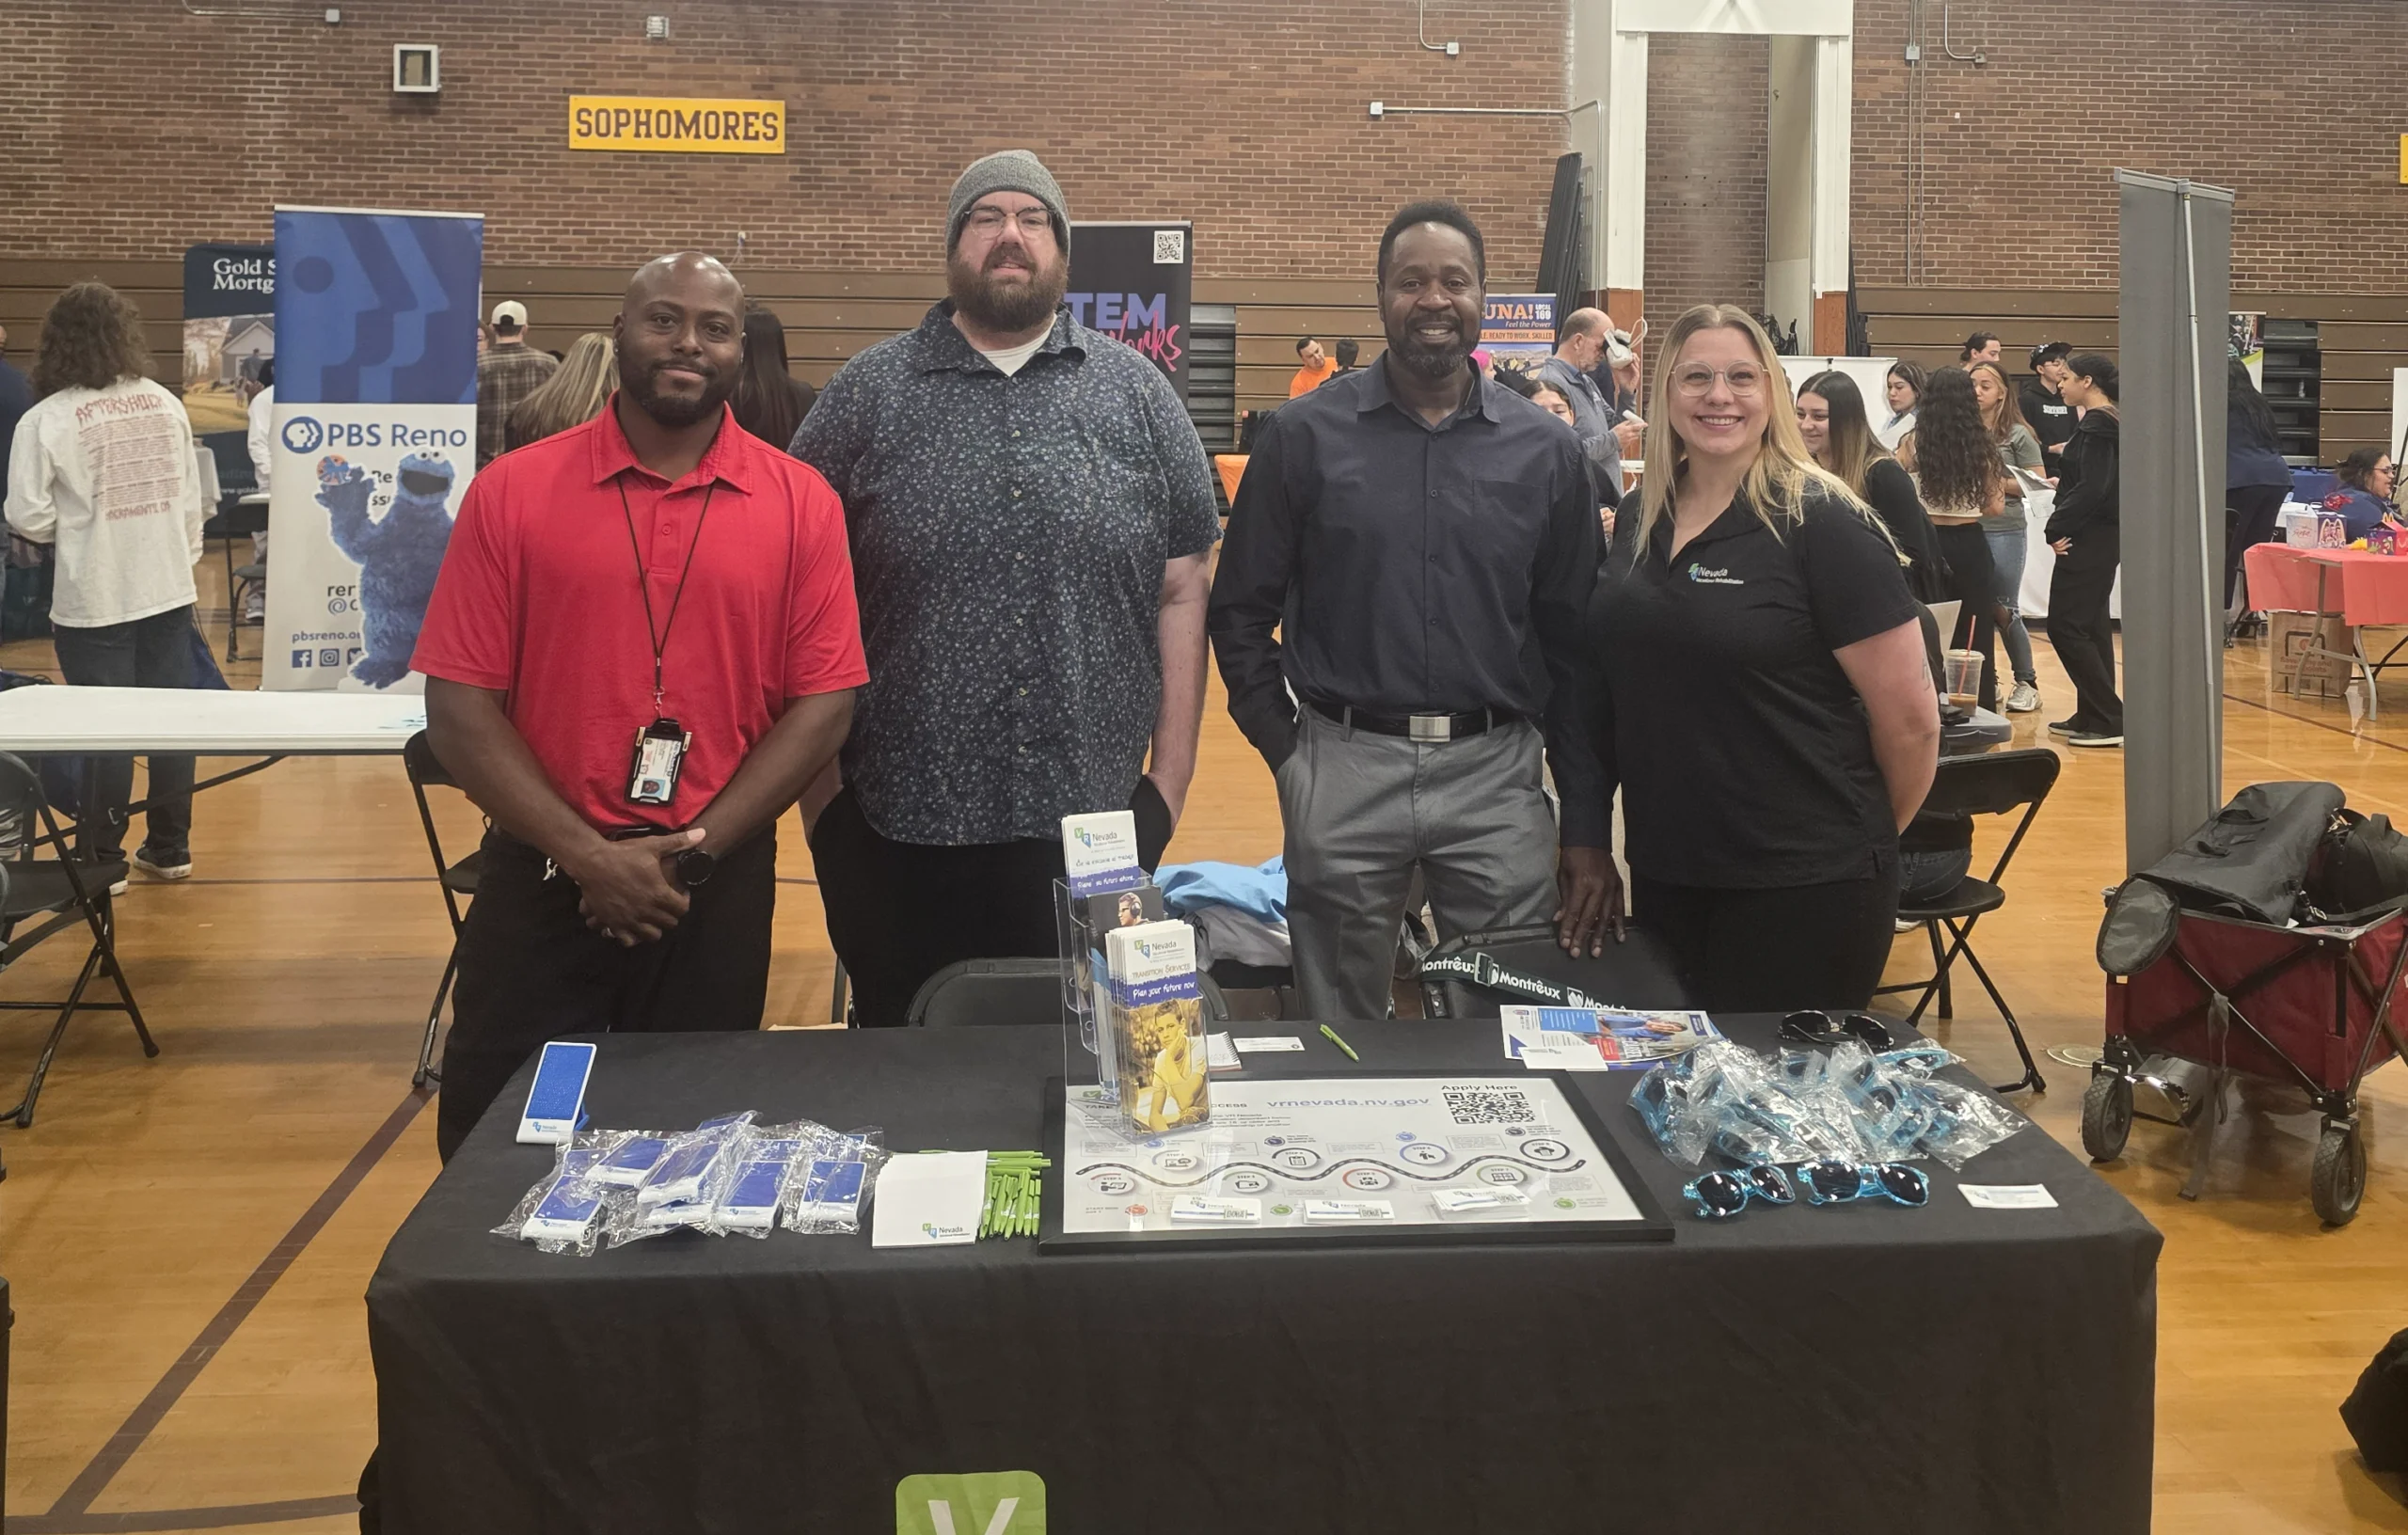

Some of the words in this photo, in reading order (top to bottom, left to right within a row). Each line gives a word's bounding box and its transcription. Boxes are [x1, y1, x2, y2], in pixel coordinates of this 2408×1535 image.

[576, 107, 779, 141] SOPHOMORES
[213, 257, 262, 275] Gold
[267, 259, 277, 275] S
[213, 274, 275, 294] Mortg
[1063, 293, 1166, 330] TEM
[1484, 304, 1533, 320] UNA!
[328, 423, 381, 447] PBS
[391, 423, 467, 447] Reno
[372, 469, 393, 483] Re
[1698, 566, 1728, 577] Nevada
[1092, 831, 1117, 842] Nevada
[1151, 941, 1178, 951] Nevada
[1422, 956, 1480, 974] ontrêux
[1133, 988, 1148, 1002] Plan
[1148, 987, 1163, 998] your
[1163, 983, 1182, 993] future
[1183, 981, 1196, 989] now
[1499, 971, 1561, 1001] Montrêux
[1267, 1099, 1430, 1107] vrnevada.nv.gov
